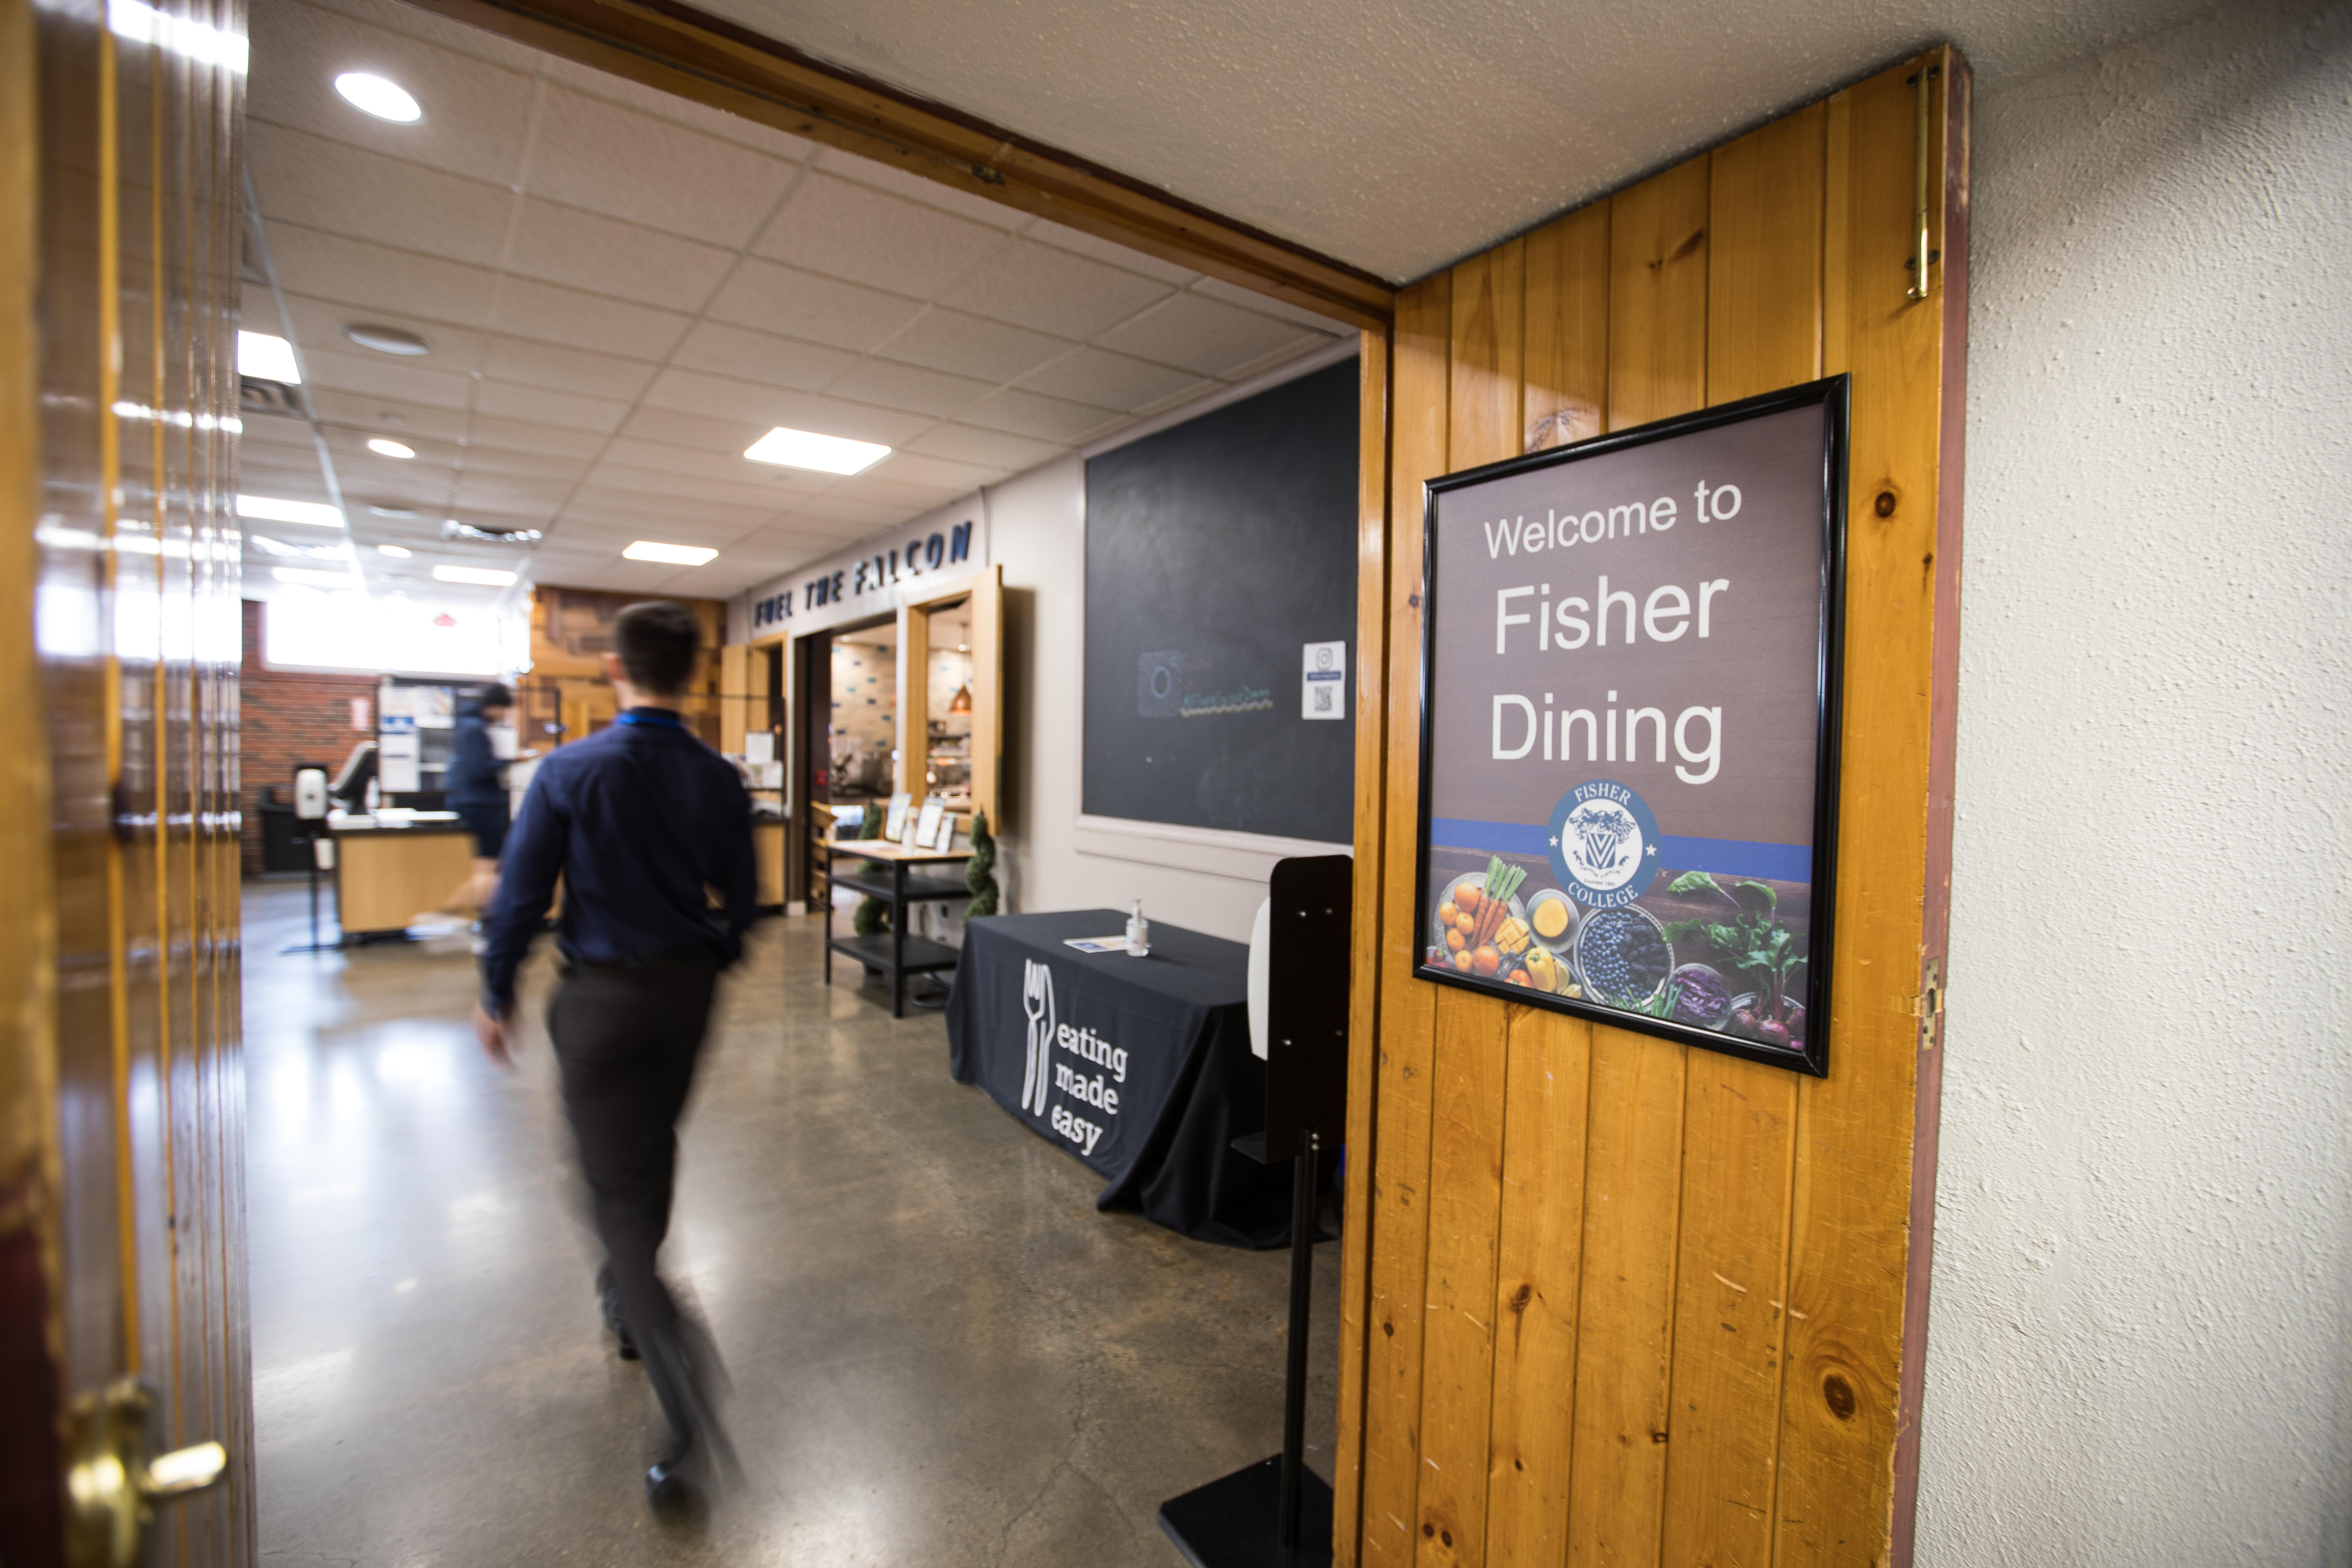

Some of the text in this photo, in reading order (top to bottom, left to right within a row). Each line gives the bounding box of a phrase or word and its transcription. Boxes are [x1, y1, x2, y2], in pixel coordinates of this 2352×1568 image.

[1484, 479, 1742, 559] Welcome to
[754, 521, 972, 628] FUEL THE FALCON
[1496, 575, 1730, 654] Fisher
[1492, 690, 1722, 784] Dining
[1574, 782, 1631, 805] FISHER
[1568, 881, 1639, 908] COLLEGE
[1057, 1023, 1128, 1083] eating
[1055, 1062, 1119, 1115] made
[1051, 1104, 1104, 1156] easy
